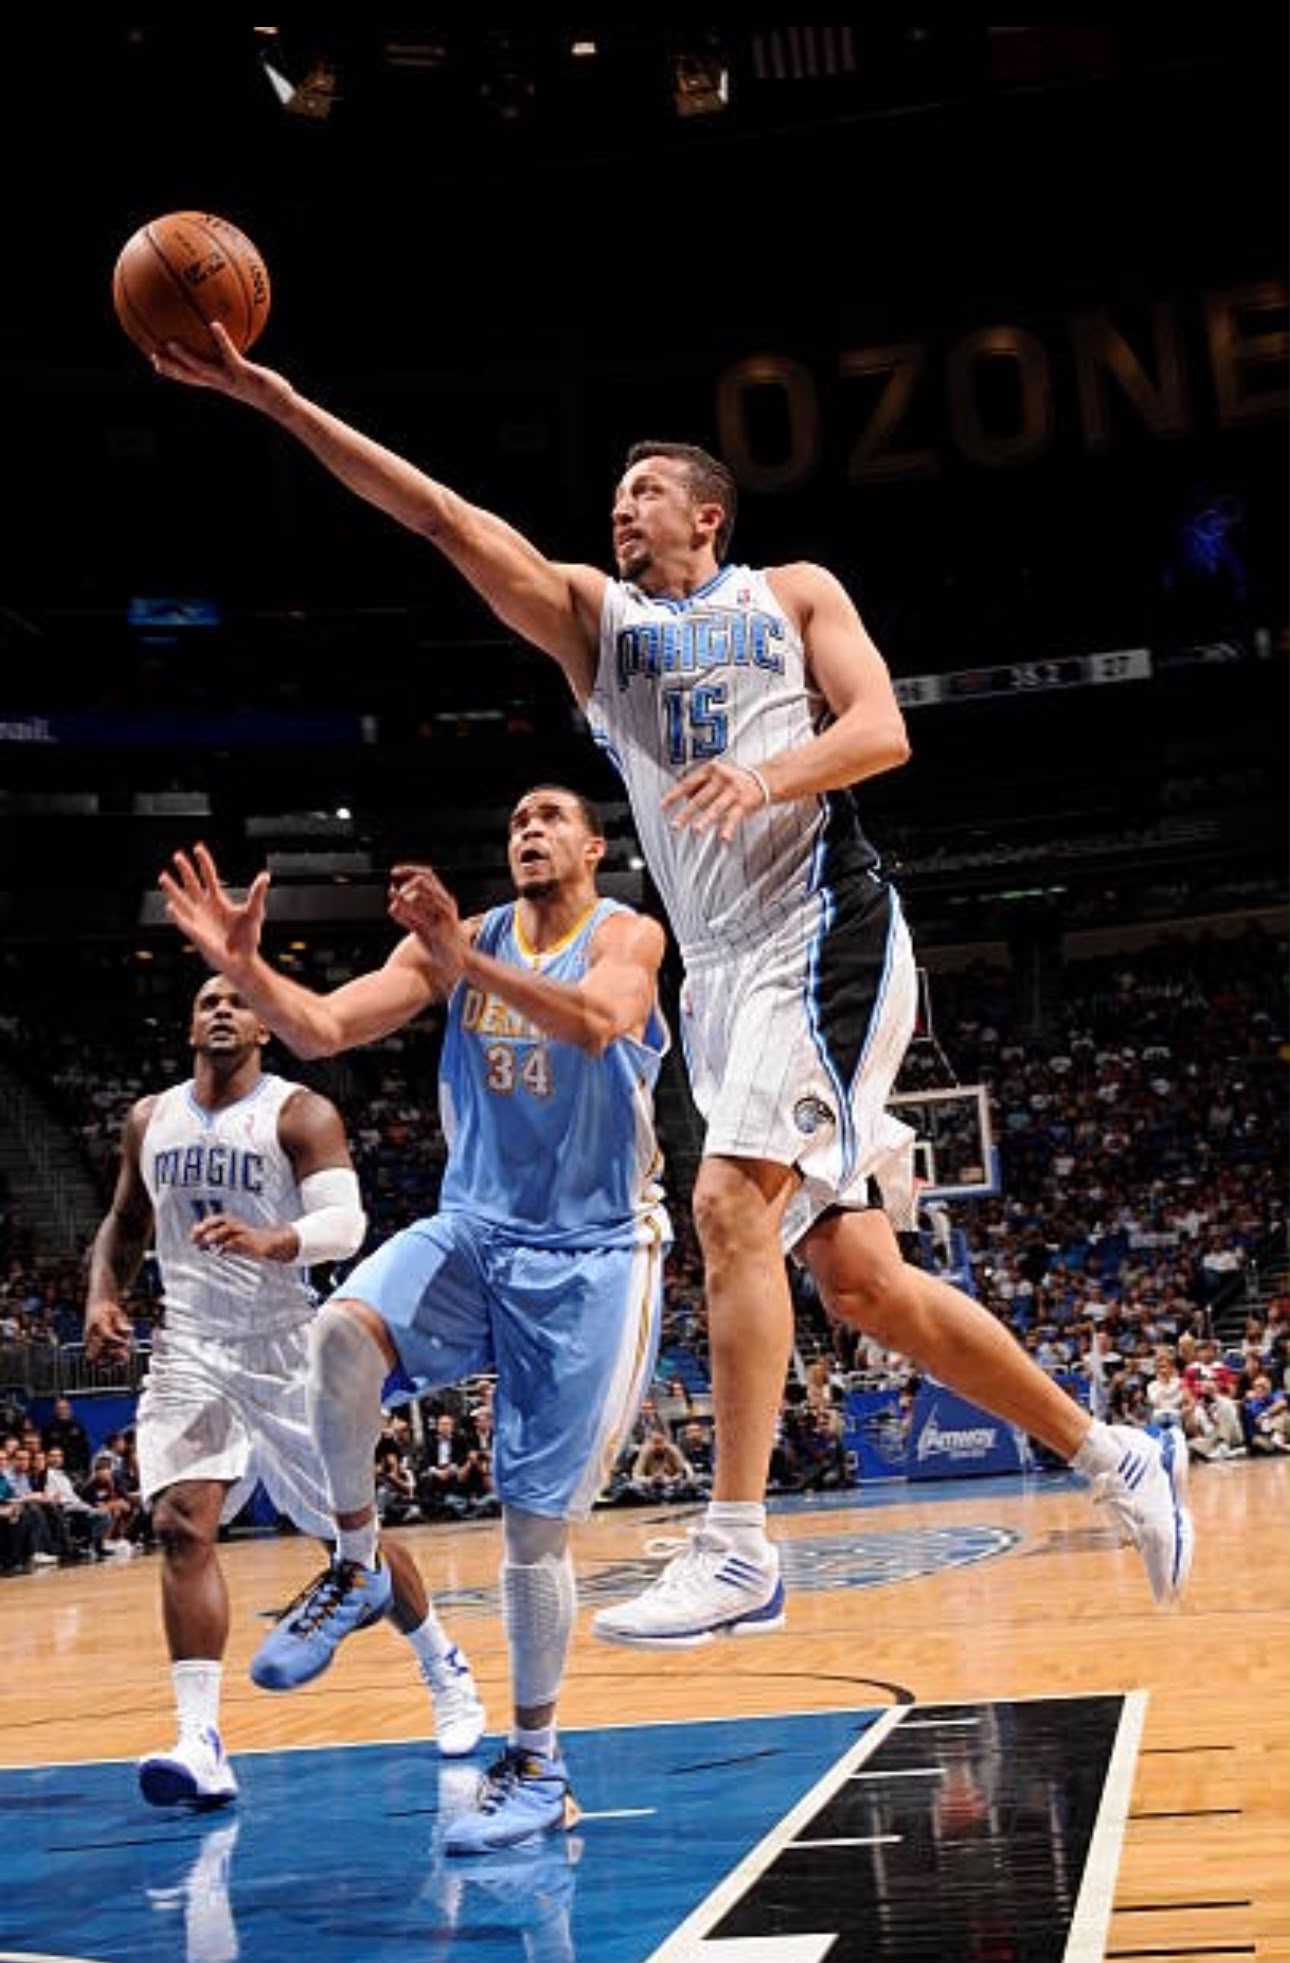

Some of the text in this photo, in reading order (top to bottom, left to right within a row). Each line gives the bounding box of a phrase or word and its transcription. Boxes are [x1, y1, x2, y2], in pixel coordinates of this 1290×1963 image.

[714, 278, 1290, 497] OZONE
[617, 611, 785, 691] MAGIC
[665, 684, 728, 764] 15
[484, 1042, 552, 1097] 34
[155, 1145, 264, 1195] MAGIC
